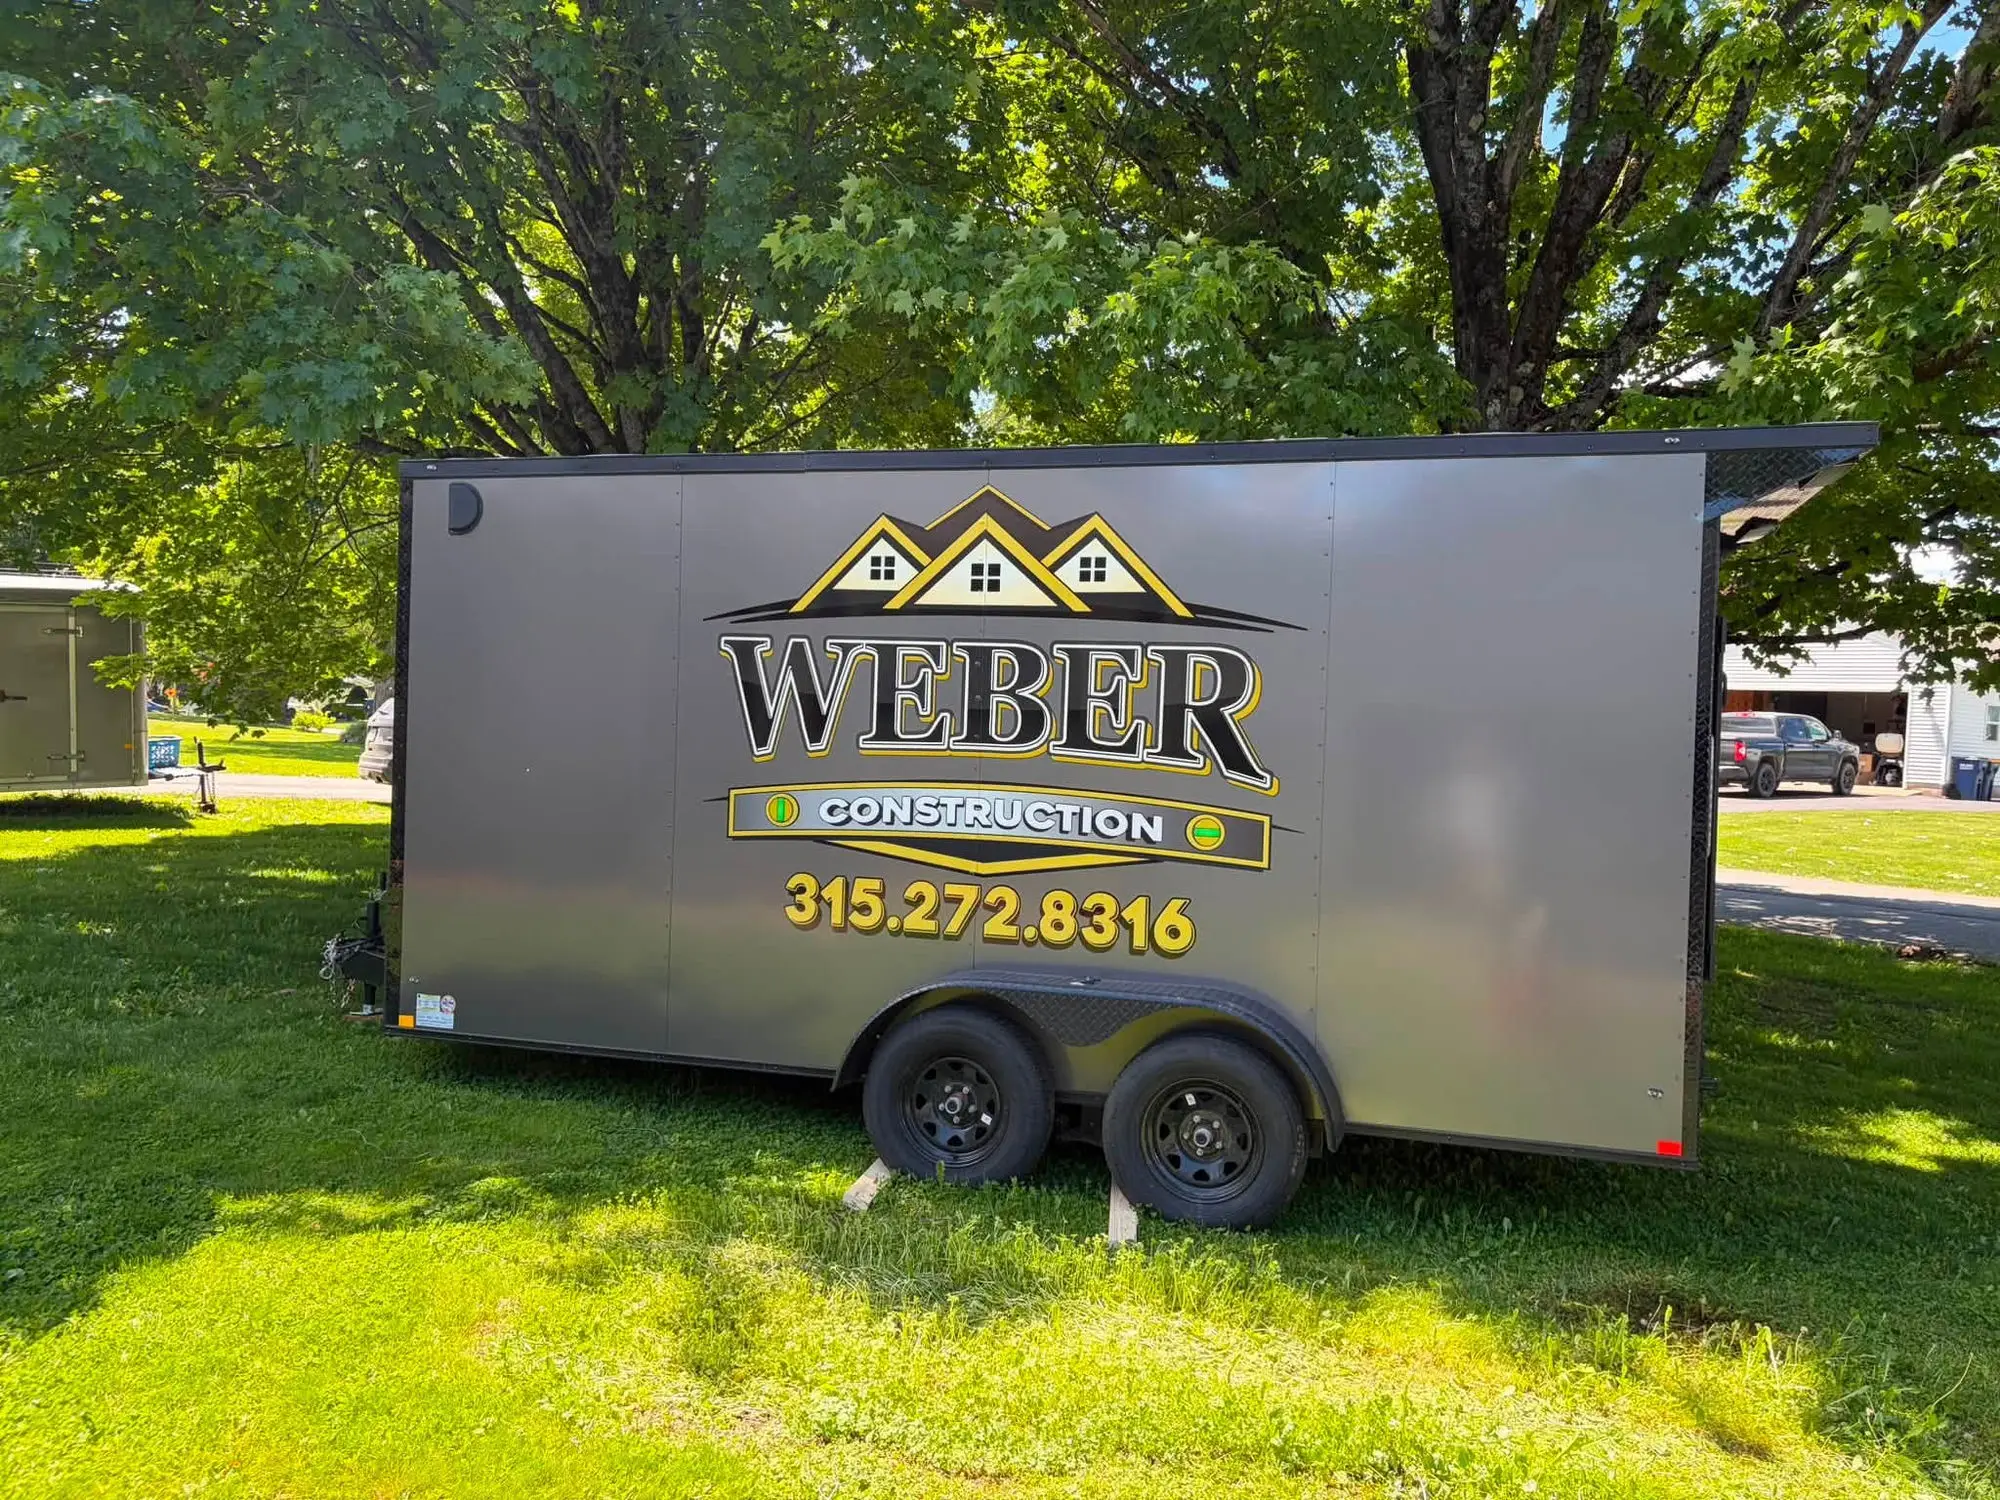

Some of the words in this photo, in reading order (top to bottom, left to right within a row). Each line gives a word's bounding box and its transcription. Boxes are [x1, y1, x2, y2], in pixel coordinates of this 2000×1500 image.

[719, 634, 1280, 796] WEBER
[818, 796, 1163, 843] CONSTRUCTION
[783, 872, 1197, 959] 315.272.8316
